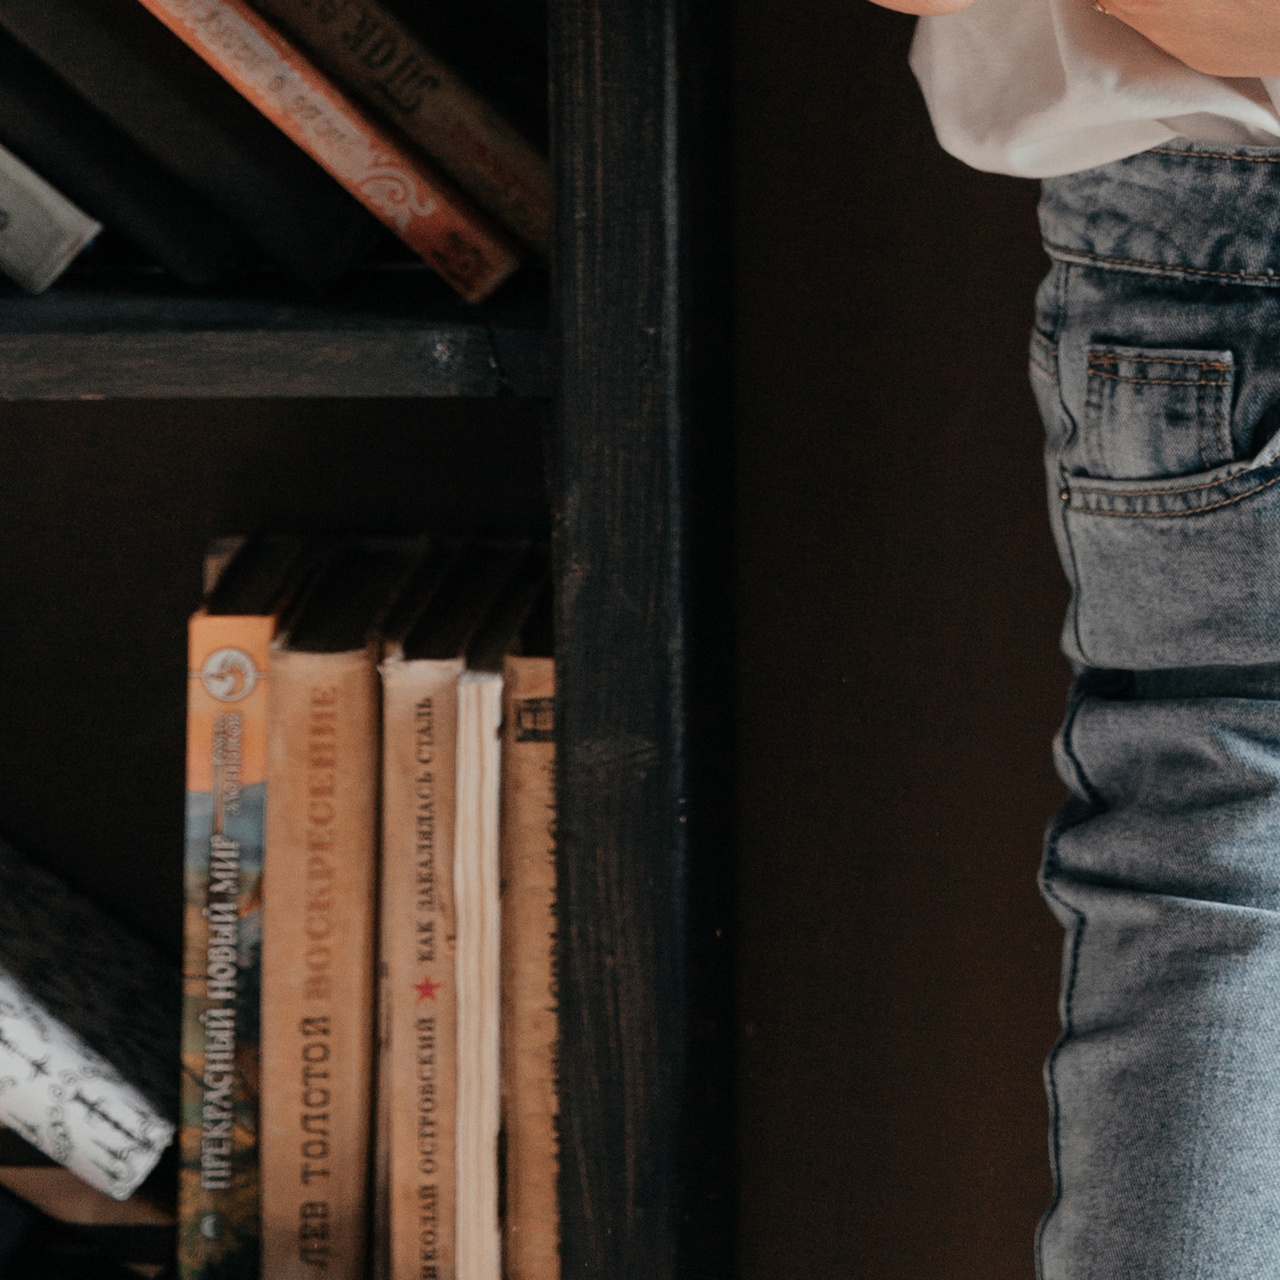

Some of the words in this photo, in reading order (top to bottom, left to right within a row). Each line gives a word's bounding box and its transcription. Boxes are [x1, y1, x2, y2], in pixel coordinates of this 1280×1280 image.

[415, 696, 435, 766] СТАЛЬ
[210, 835, 240, 894] МИР
[303, 684, 338, 1002] ВОСКРЕСЕНИЕ
[415, 771, 435, 912] ЗАКАЛЯЛАСЬ
[202, 902, 239, 1000] НОВЫЙ
[416, 920, 435, 963] КАК
[199, 1008, 238, 1191] ПРЕКРАСНЫЙ
[299, 1016, 332, 1185] ТОЛСТОЙ
[416, 1016, 438, 1175] ОСТРОВСКИЙ
